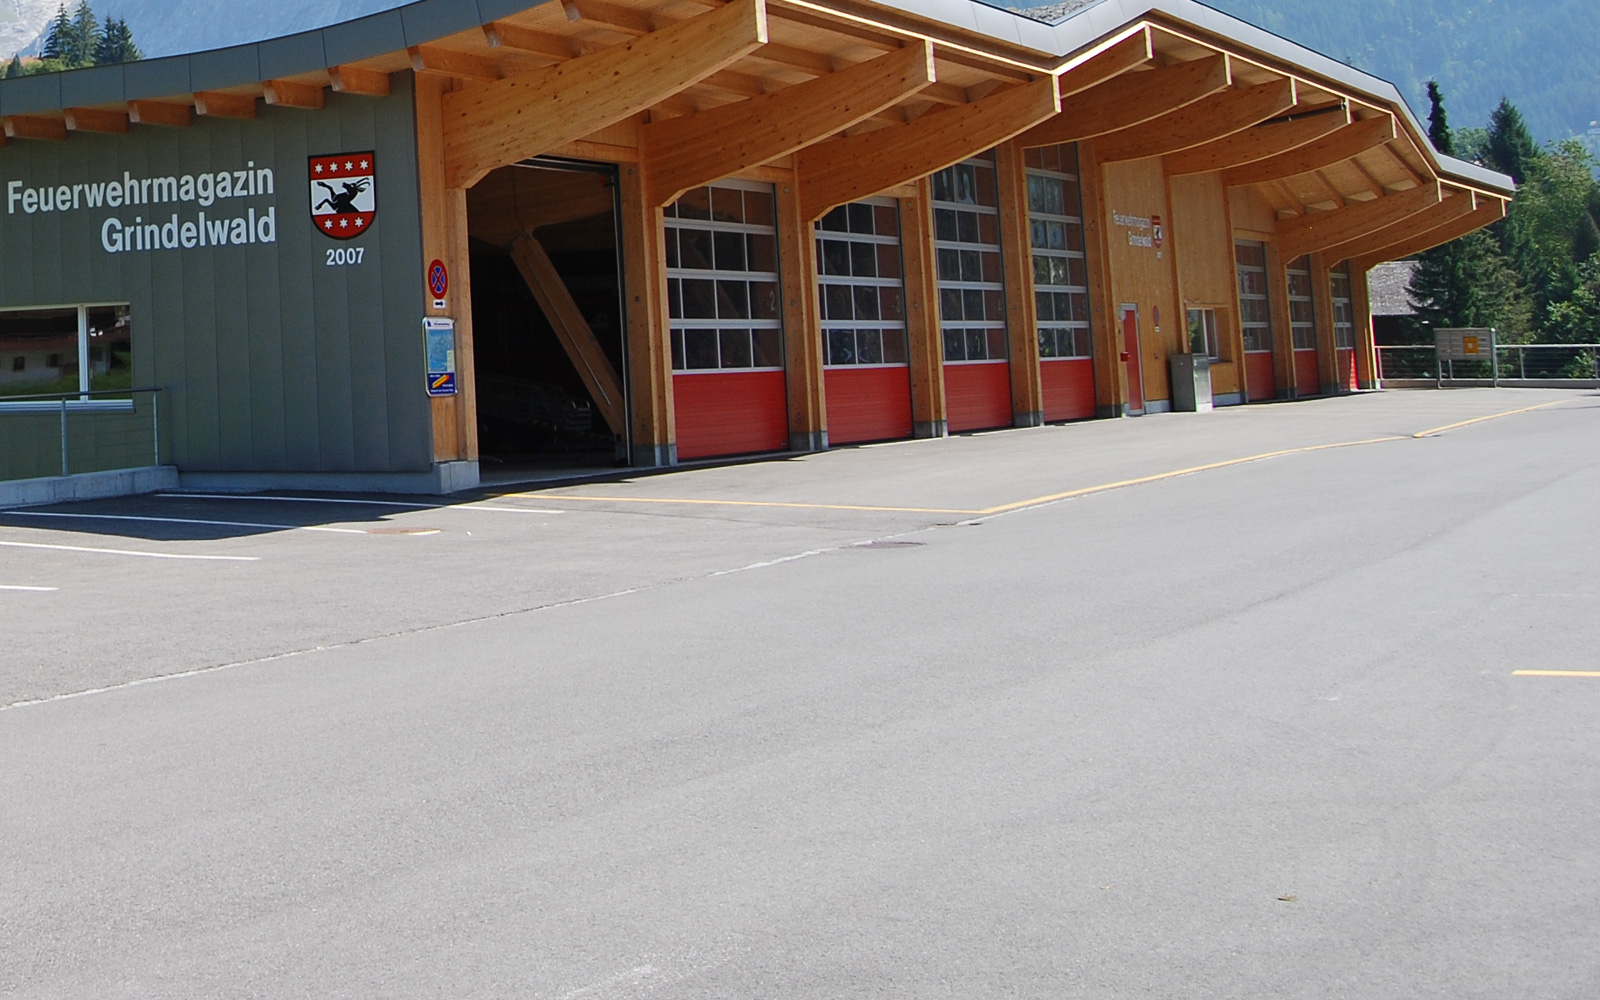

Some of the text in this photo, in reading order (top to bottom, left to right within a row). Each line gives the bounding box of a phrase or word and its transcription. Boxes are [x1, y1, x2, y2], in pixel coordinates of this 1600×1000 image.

[7, 161, 274, 214] Feuerwehrmagazin
[101, 206, 276, 253] Grindelwald
[325, 247, 365, 266] 2007
